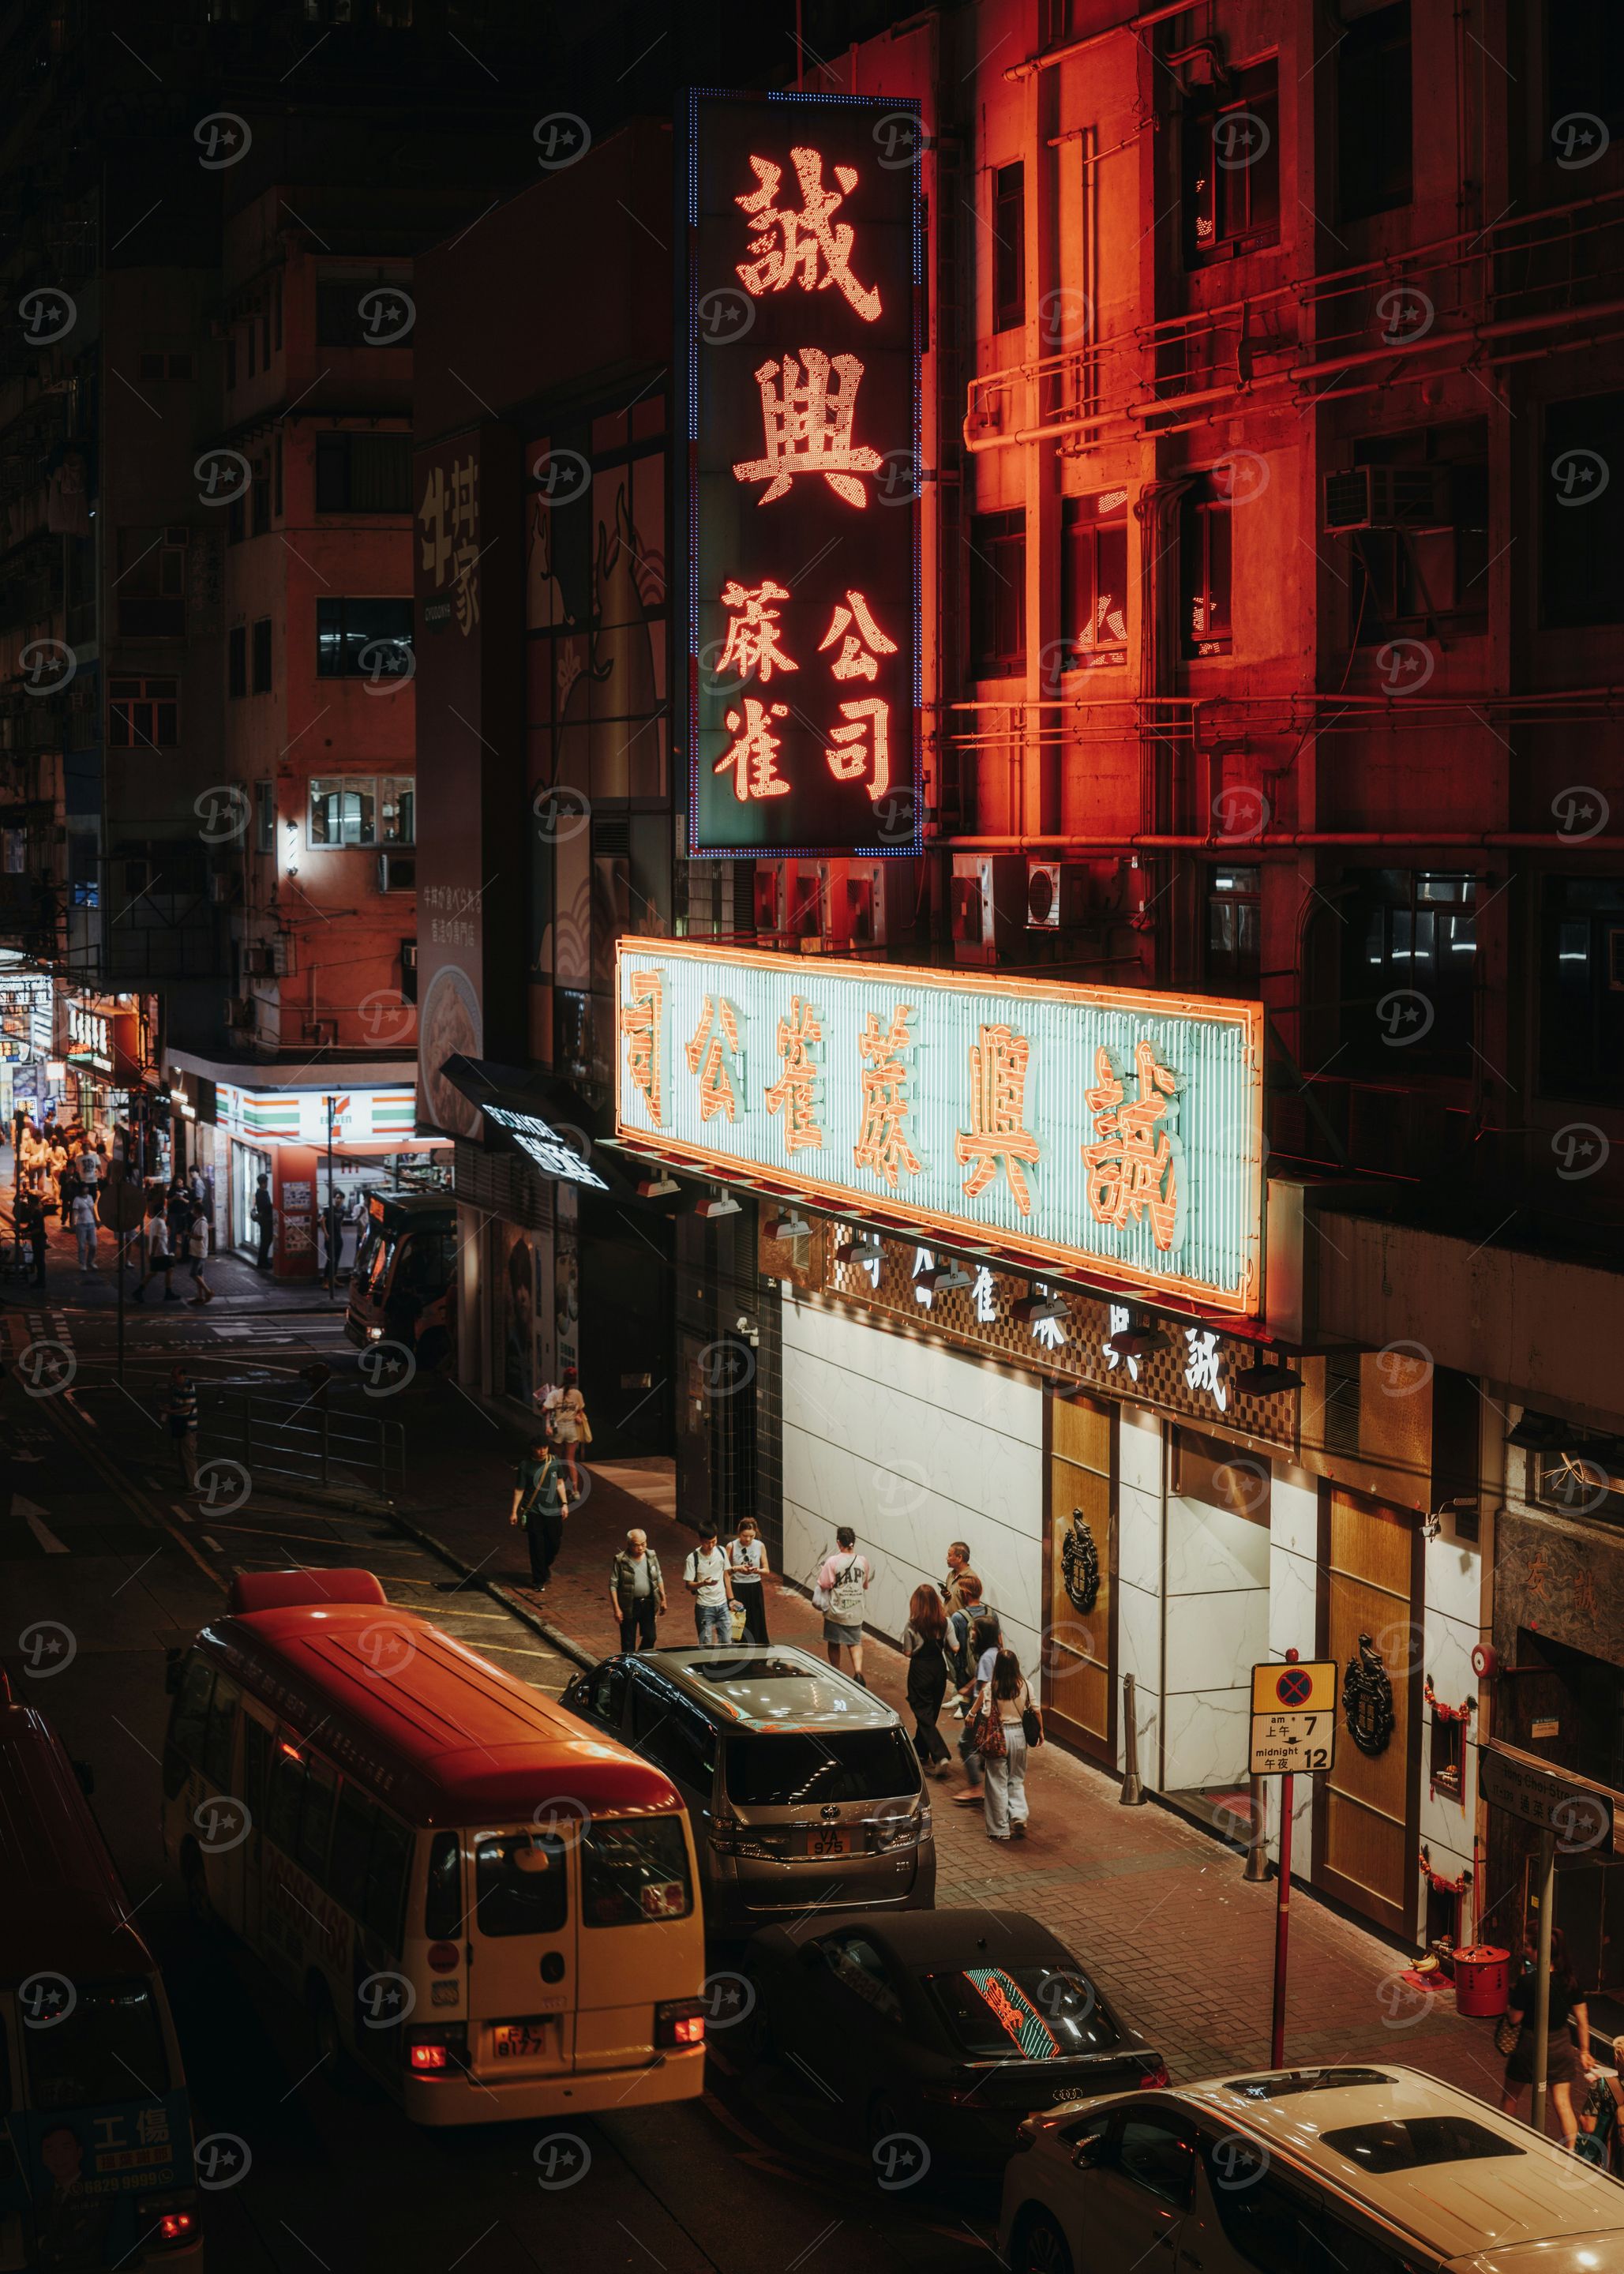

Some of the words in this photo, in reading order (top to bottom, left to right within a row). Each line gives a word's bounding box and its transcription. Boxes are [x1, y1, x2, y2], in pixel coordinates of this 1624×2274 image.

[733, 147, 883, 509] 誠興
[818, 590, 898, 801] 公司
[1266, 1725, 1290, 1737] 上午
[1304, 1717, 1318, 1736] 7
[1256, 1747, 1299, 1757] midnight
[1304, 1748, 1328, 1768] 12
[1264, 1758, 1288, 1770] 午夜
[1502, 1763, 1522, 1786] Tung
[1525, 1774, 1547, 1795] Choi
[1550, 1784, 1581, 1807] Street
[820, 1832, 838, 1842] VA
[814, 1841, 843, 1854] 975
[92, 2107, 171, 2149] 工傷
